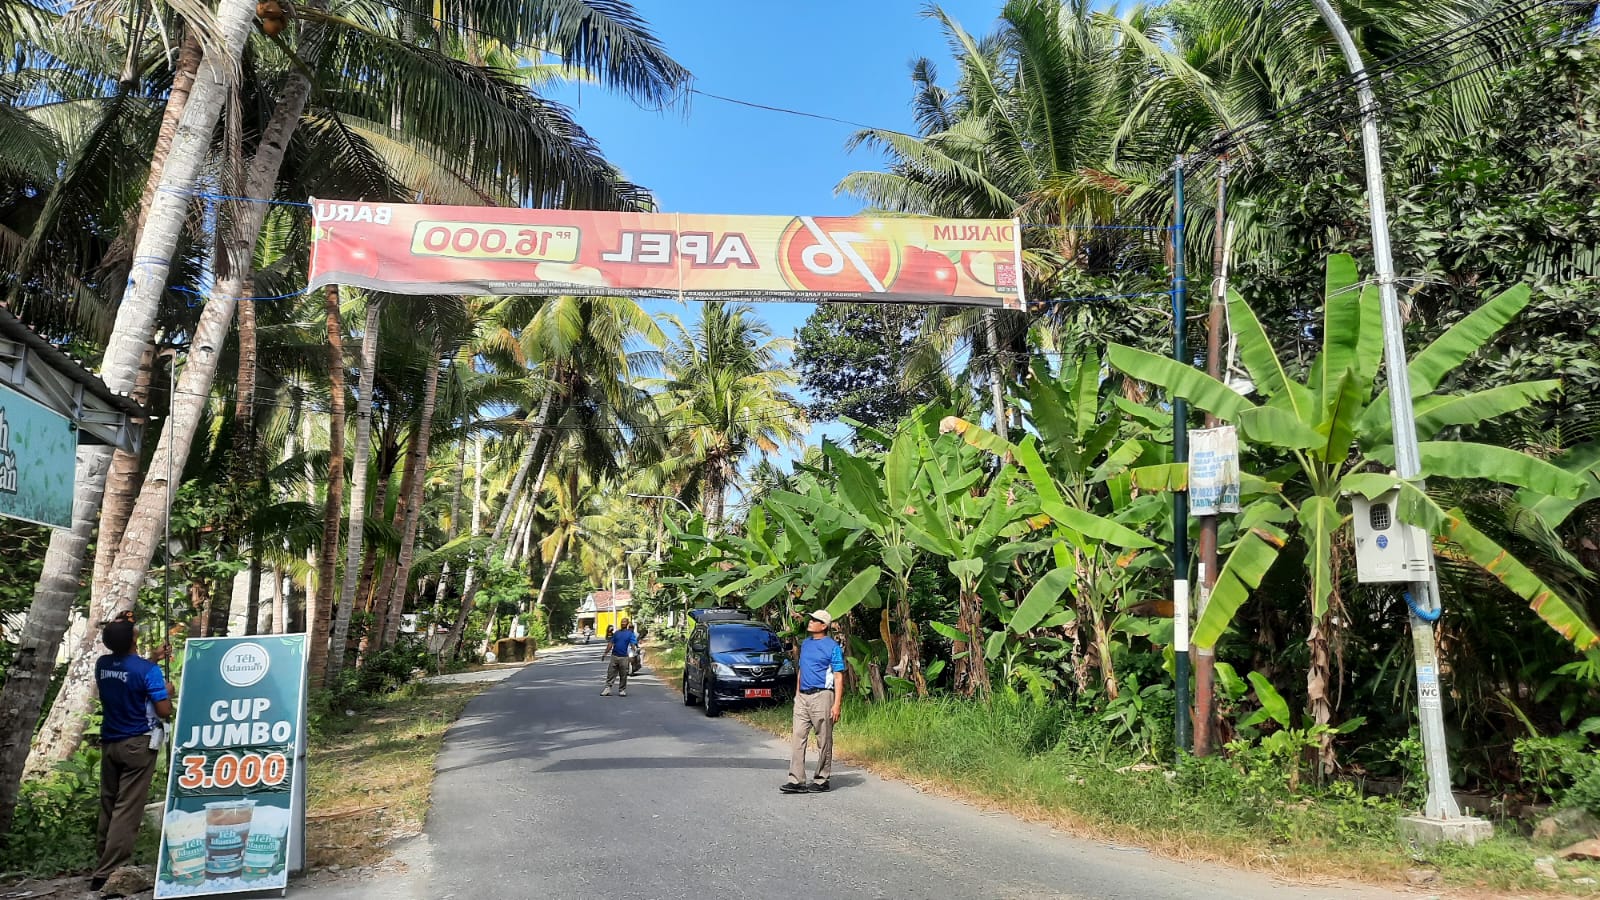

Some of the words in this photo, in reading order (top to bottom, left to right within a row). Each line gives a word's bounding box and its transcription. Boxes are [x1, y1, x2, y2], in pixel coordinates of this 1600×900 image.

[1420, 689, 1438, 697] WC
[209, 697, 271, 723] CUP
[182, 720, 292, 749] JUMBO
[178, 752, 287, 789] 3.000
